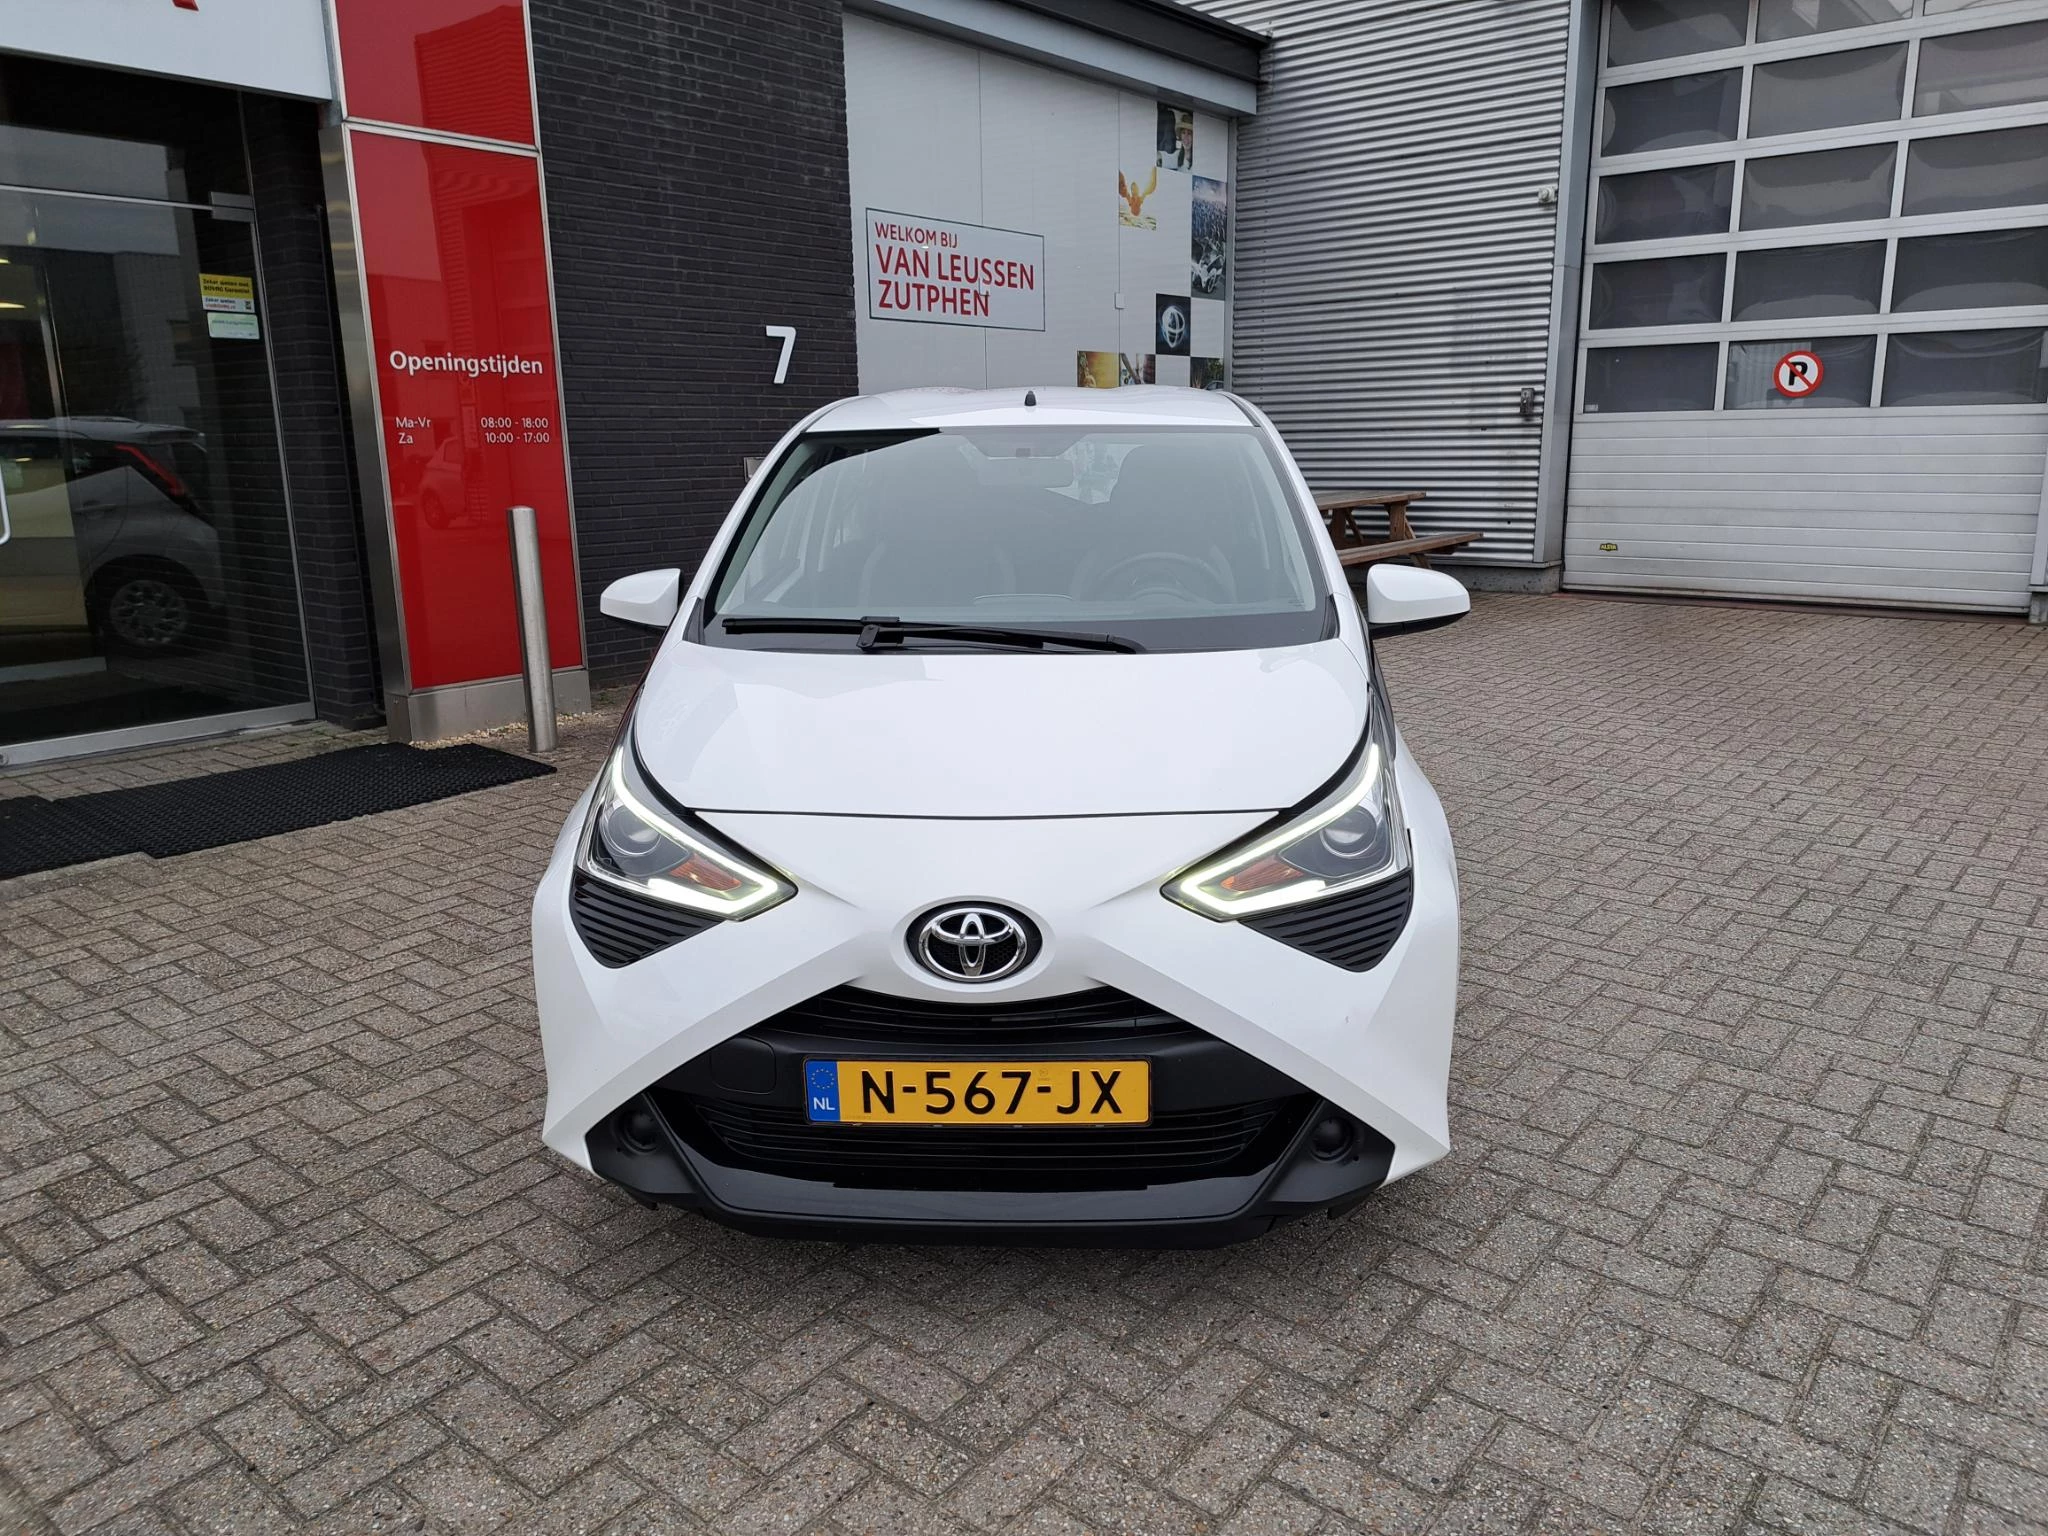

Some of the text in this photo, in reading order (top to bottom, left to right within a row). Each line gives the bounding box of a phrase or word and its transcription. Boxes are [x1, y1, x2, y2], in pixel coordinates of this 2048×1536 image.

[875, 222, 958, 249] WELKOM BIJ
[875, 244, 1034, 290] VAN LEUSSEN
[878, 279, 990, 317] ZUTPHEN
[389, 350, 543, 378] Openingstijden
[766, 325, 797, 384] 7
[1788, 361, 1808, 386] P
[396, 416, 431, 429] Ma-Vr
[480, 417, 512, 429] 08:00
[521, 417, 549, 429] 18:00
[398, 432, 414, 444] Za
[485, 432, 514, 444] 10:00
[523, 432, 550, 444] 17:00
[813, 1070, 1122, 1115] NL N-567-JX
